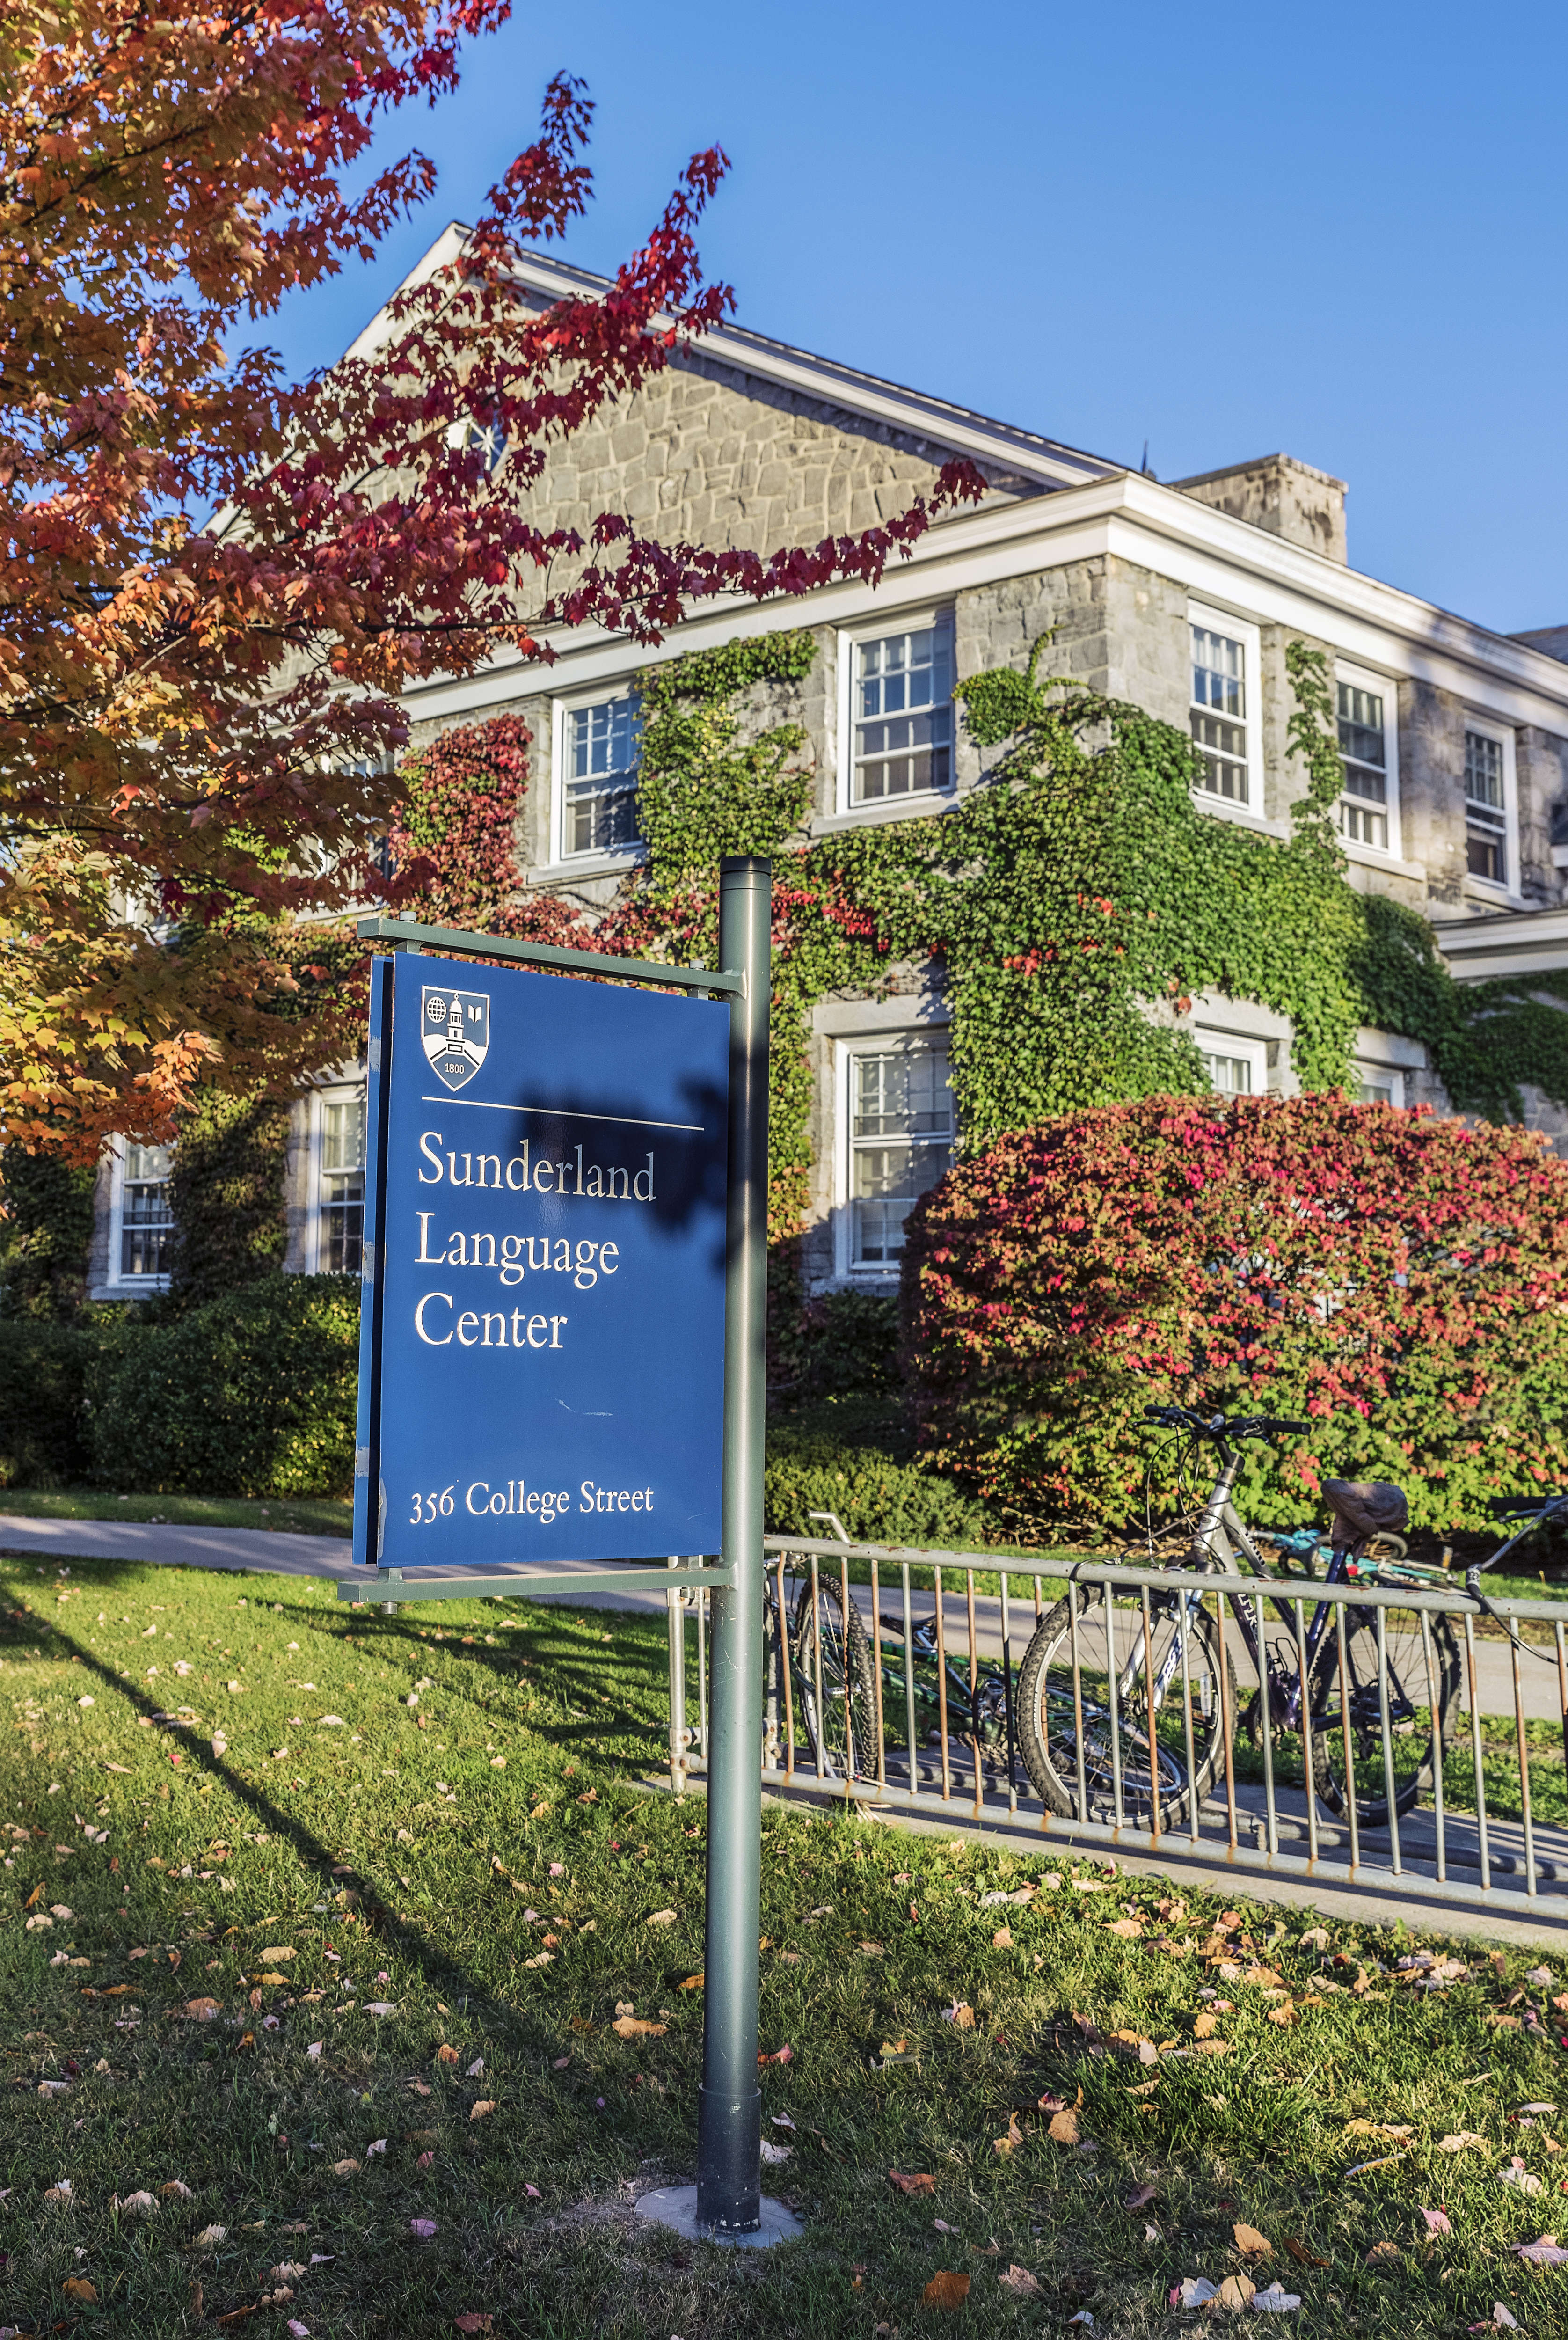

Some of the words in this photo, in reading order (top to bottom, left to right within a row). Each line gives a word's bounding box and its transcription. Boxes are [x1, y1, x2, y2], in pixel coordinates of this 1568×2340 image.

[445, 1063, 465, 1074] 1800
[418, 1131, 657, 1202] Sunderland
[414, 1211, 619, 1290] Language
[414, 1292, 568, 1348] Center
[409, 1485, 454, 1524] 356
[466, 1480, 570, 1524] College
[580, 1481, 654, 1513] Street
